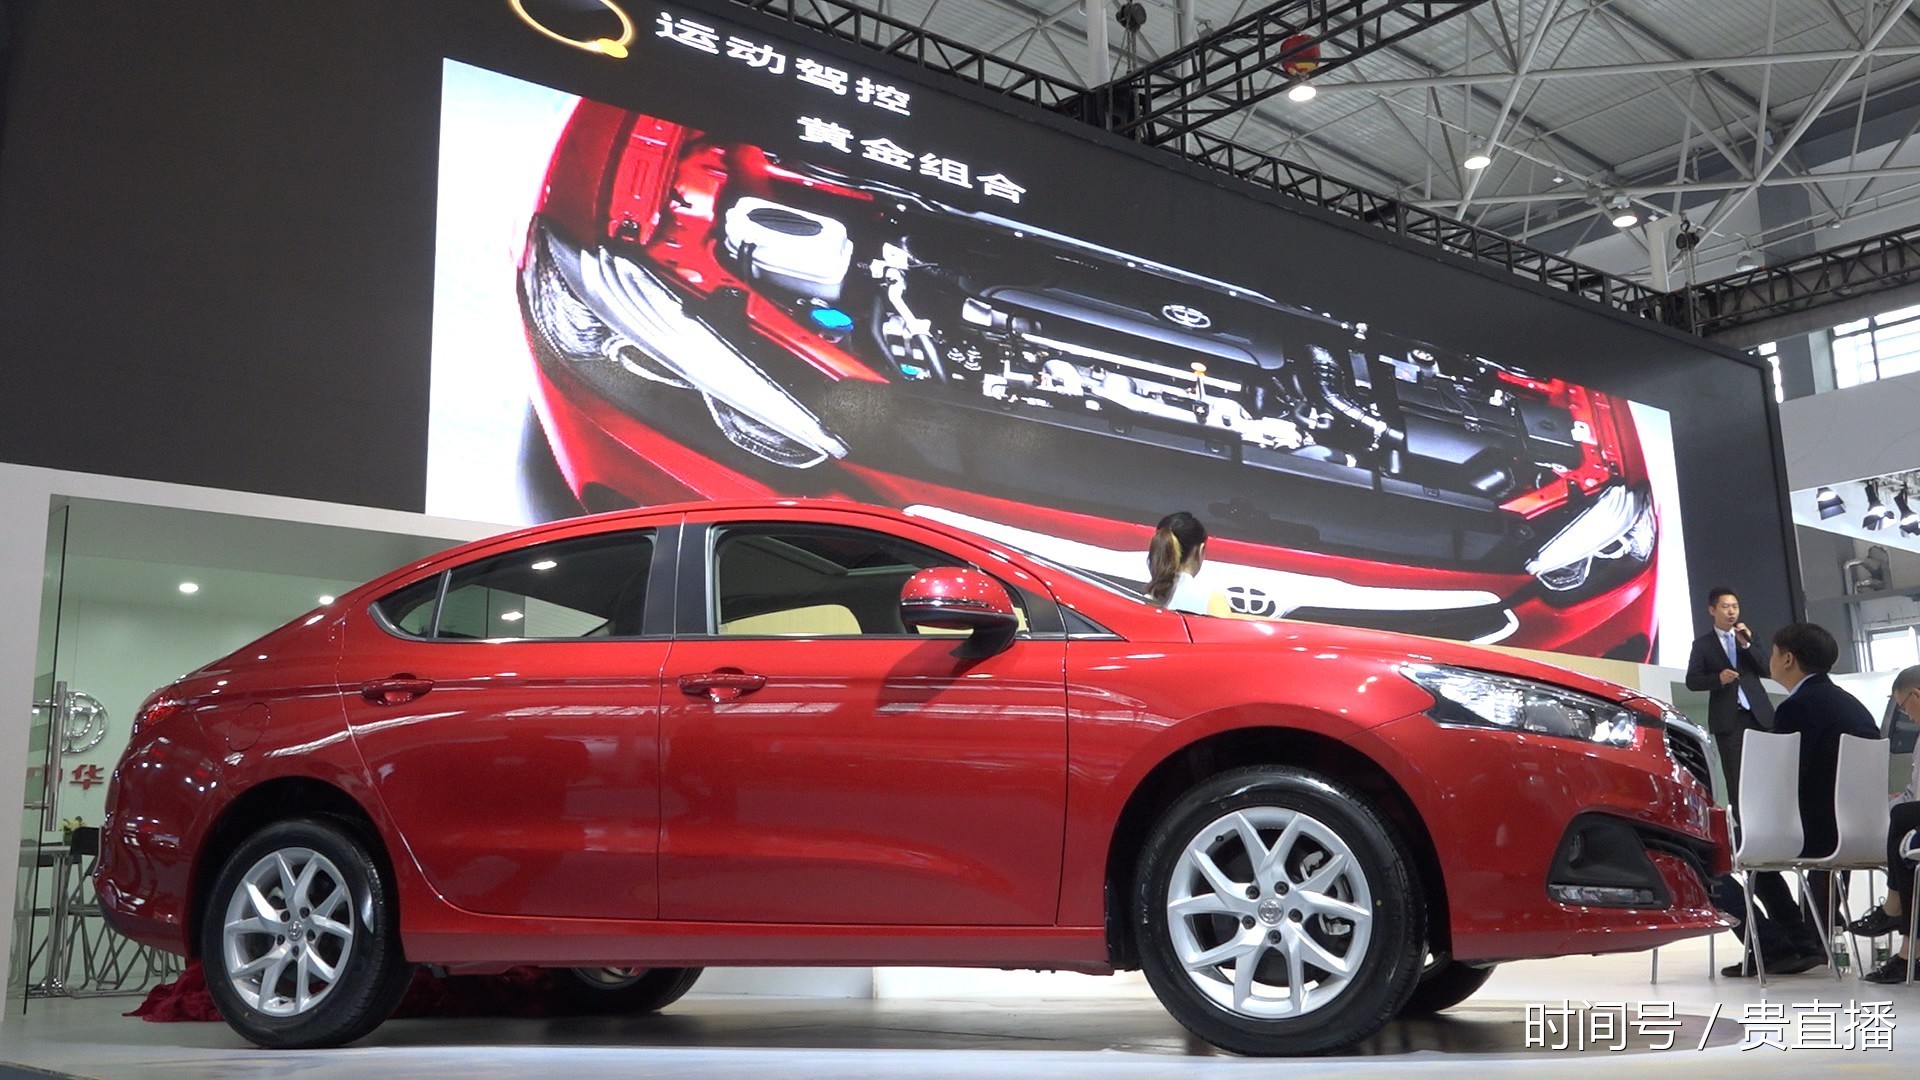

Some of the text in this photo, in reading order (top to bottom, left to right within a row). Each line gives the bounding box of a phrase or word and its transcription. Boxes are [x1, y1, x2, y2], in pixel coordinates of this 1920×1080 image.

[655, 11, 911, 117] 运动驾控
[796, 115, 1027, 204] 黄金组合
